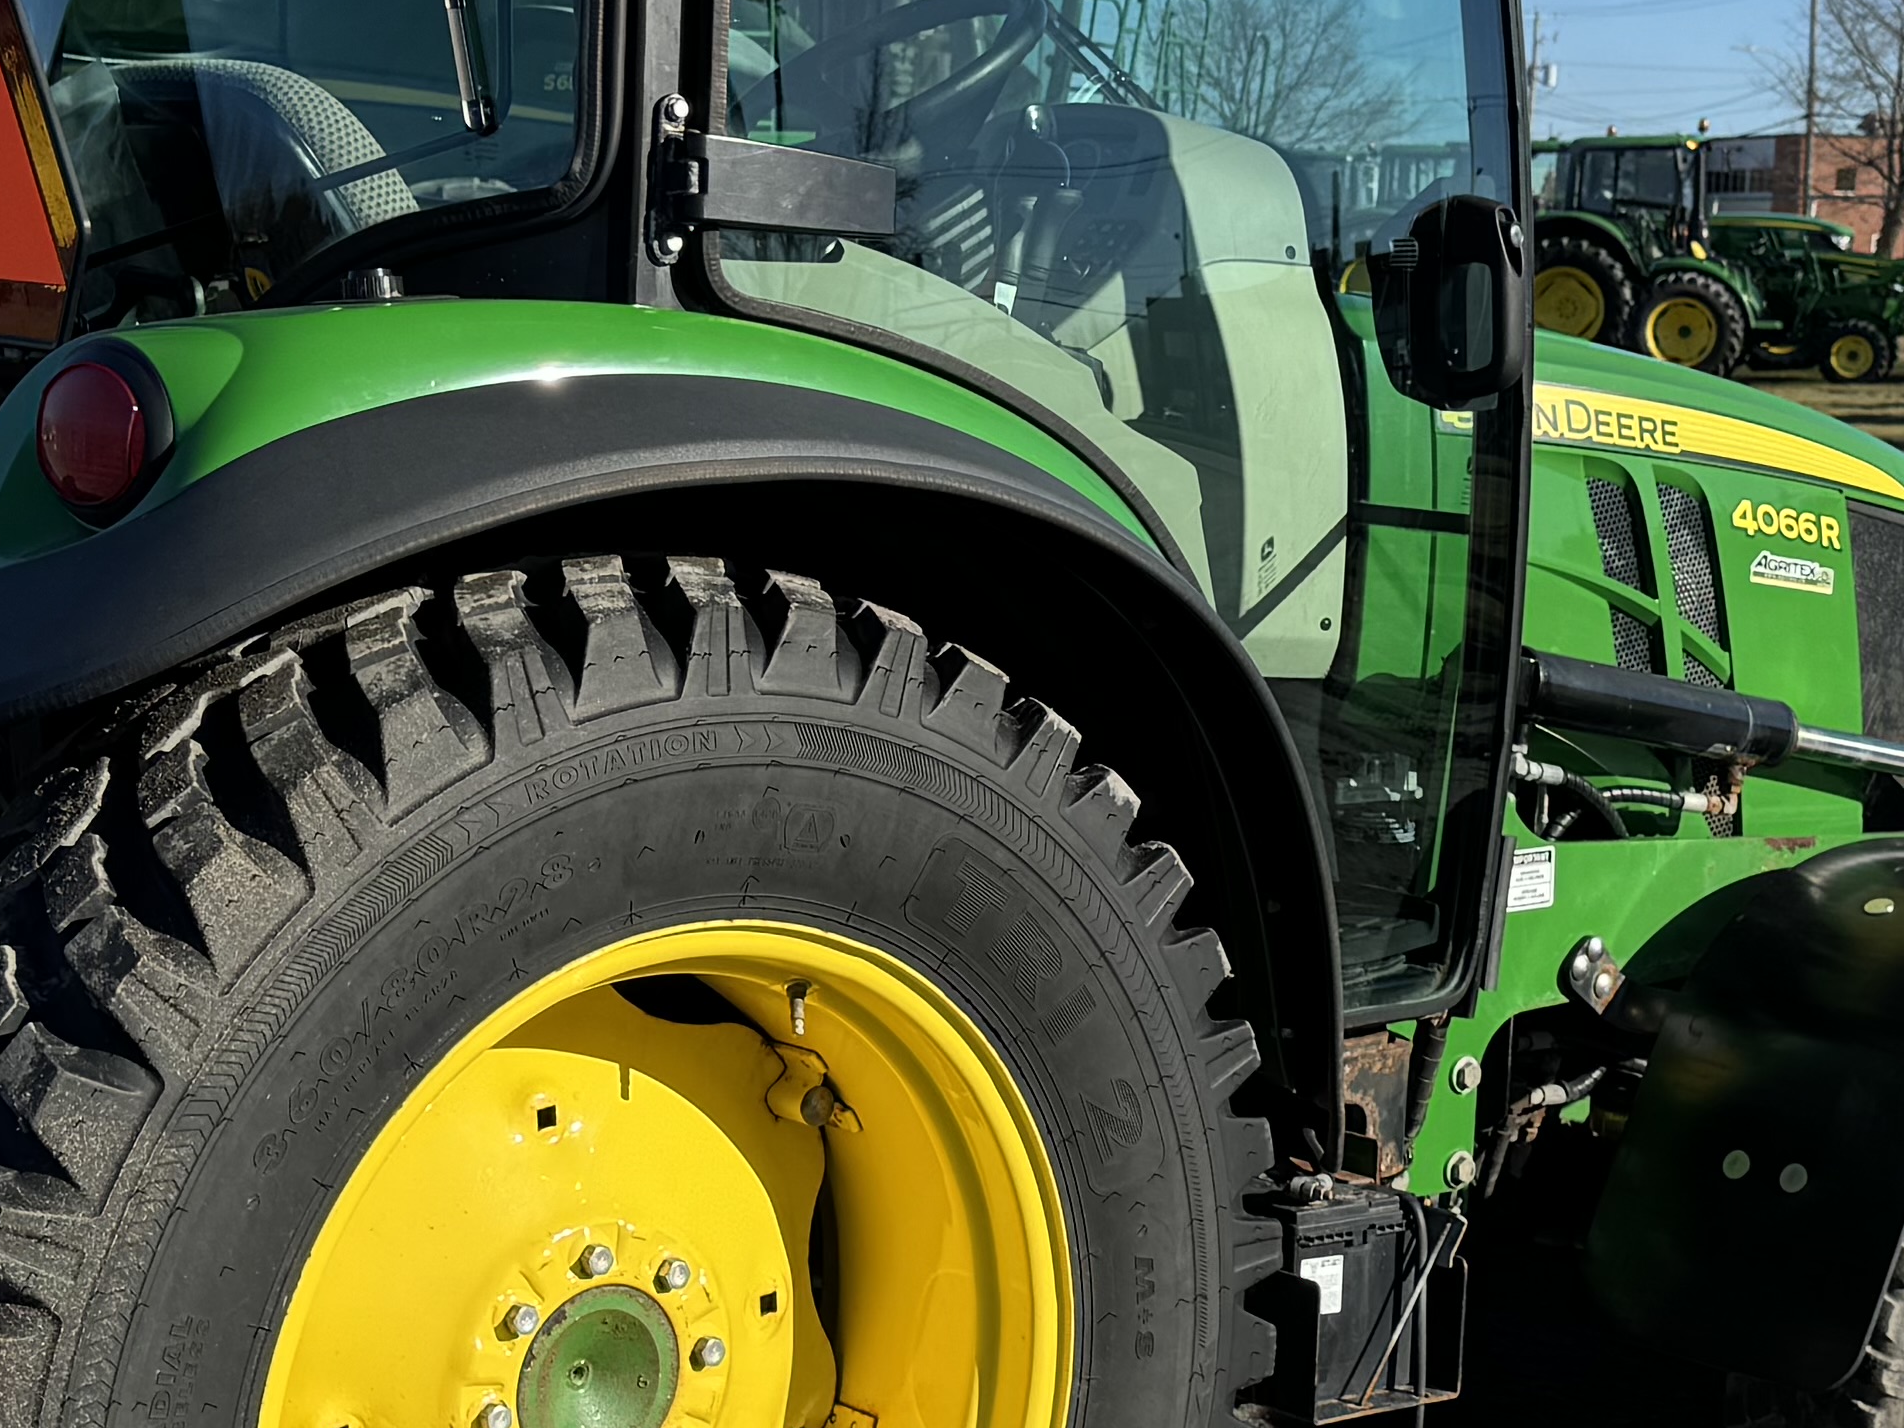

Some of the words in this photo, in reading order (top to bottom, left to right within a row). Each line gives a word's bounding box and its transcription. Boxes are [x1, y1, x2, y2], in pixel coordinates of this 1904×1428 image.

[1564, 399, 1680, 448] DEERE
[1732, 499, 1841, 550] 4066R
[525, 729, 718, 805] ROTATION
[943, 858, 1097, 1047] TRI
[1079, 1077, 1144, 1165] 2
